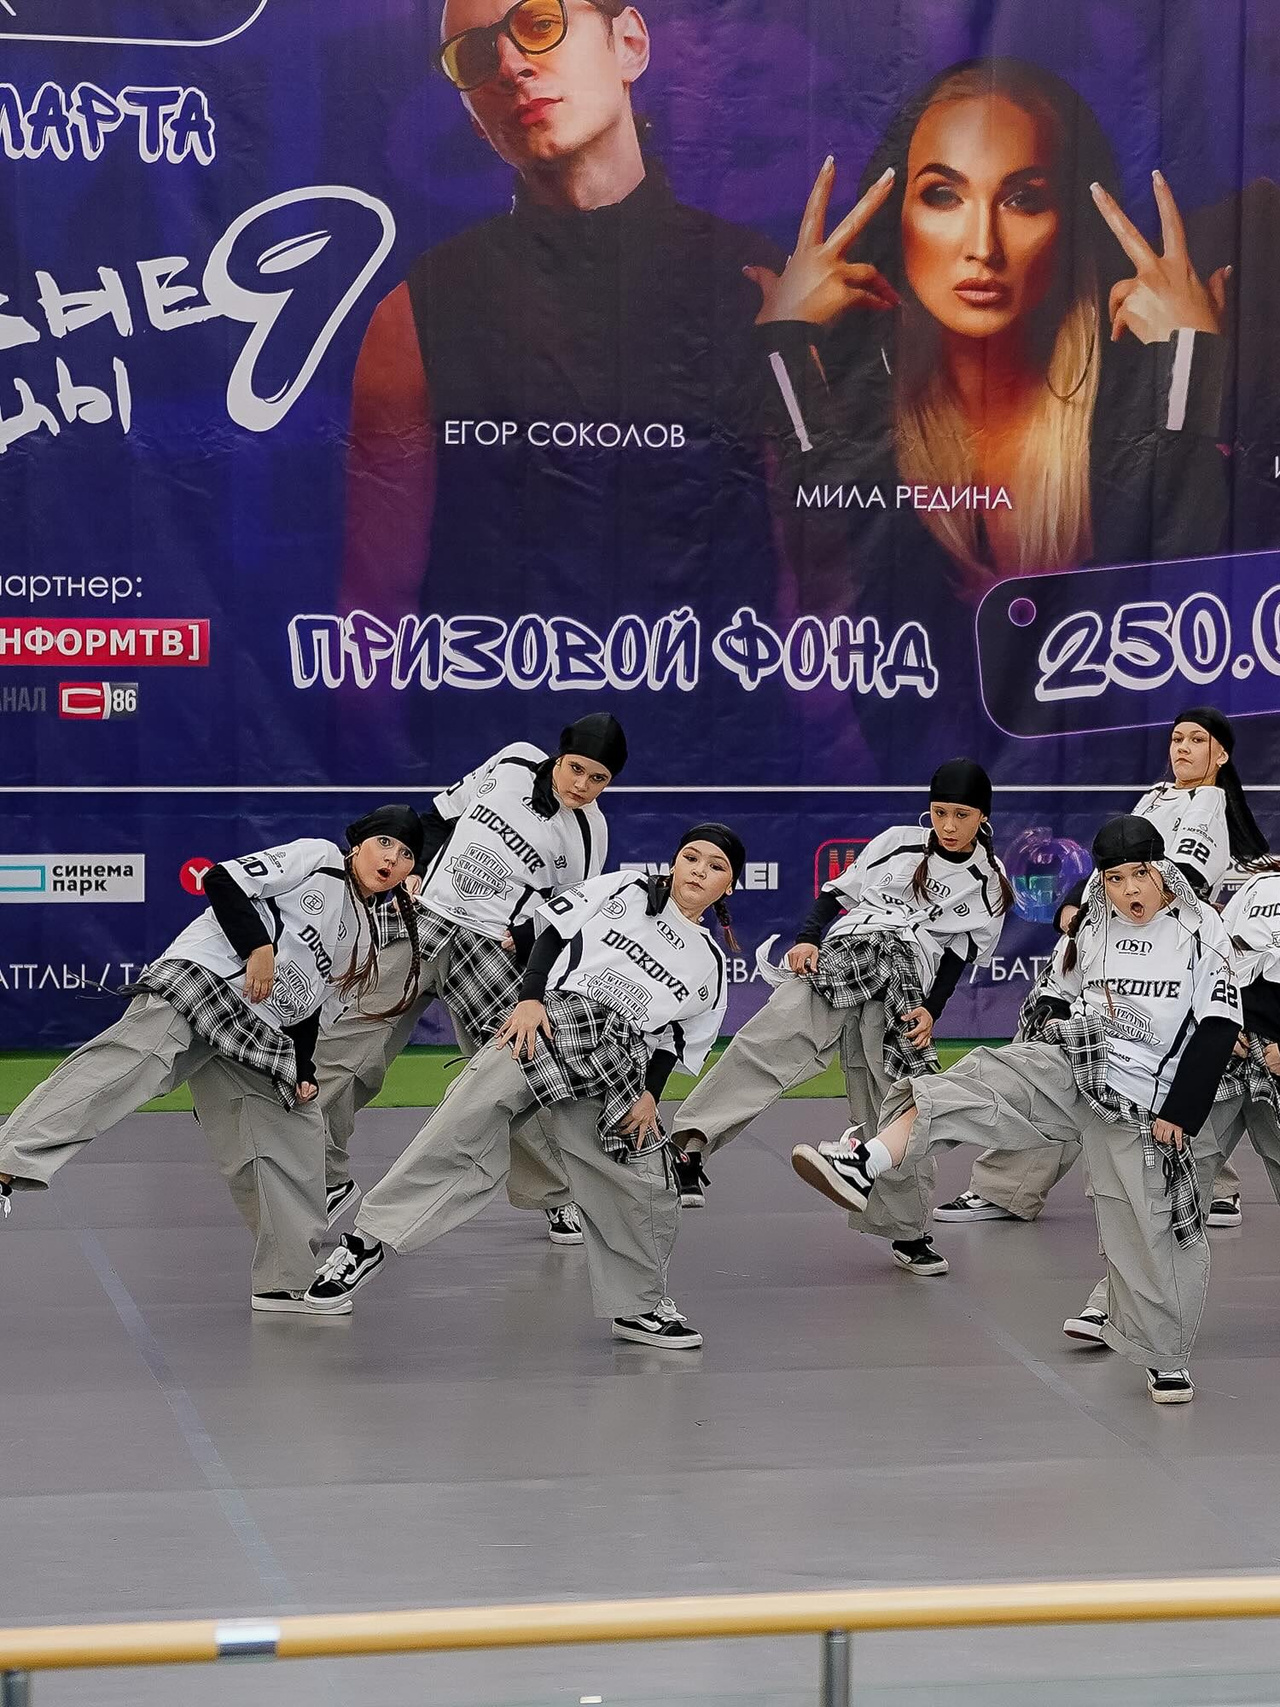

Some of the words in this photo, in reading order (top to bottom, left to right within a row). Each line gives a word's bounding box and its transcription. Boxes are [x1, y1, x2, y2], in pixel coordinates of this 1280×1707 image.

[444, 421, 517, 445] ЕГОР
[527, 423, 686, 448] СОКОЛОВ
[796, 485, 886, 510] МИЛА
[896, 486, 1013, 514] РЕДИНА
[0, 575, 143, 604] артнер:
[288, 607, 699, 692] ПРИЗОВОЙ
[712, 606, 940, 698] ФОНД
[0, 687, 46, 712] НАЛ
[468, 803, 547, 875] DUCKDIVE
[1176, 838, 1211, 866] 22
[52, 865, 134, 878] синема
[52, 878, 107, 896] парк
[600, 928, 691, 1004] DUCKDIVE
[1211, 979, 1239, 1009] 22
